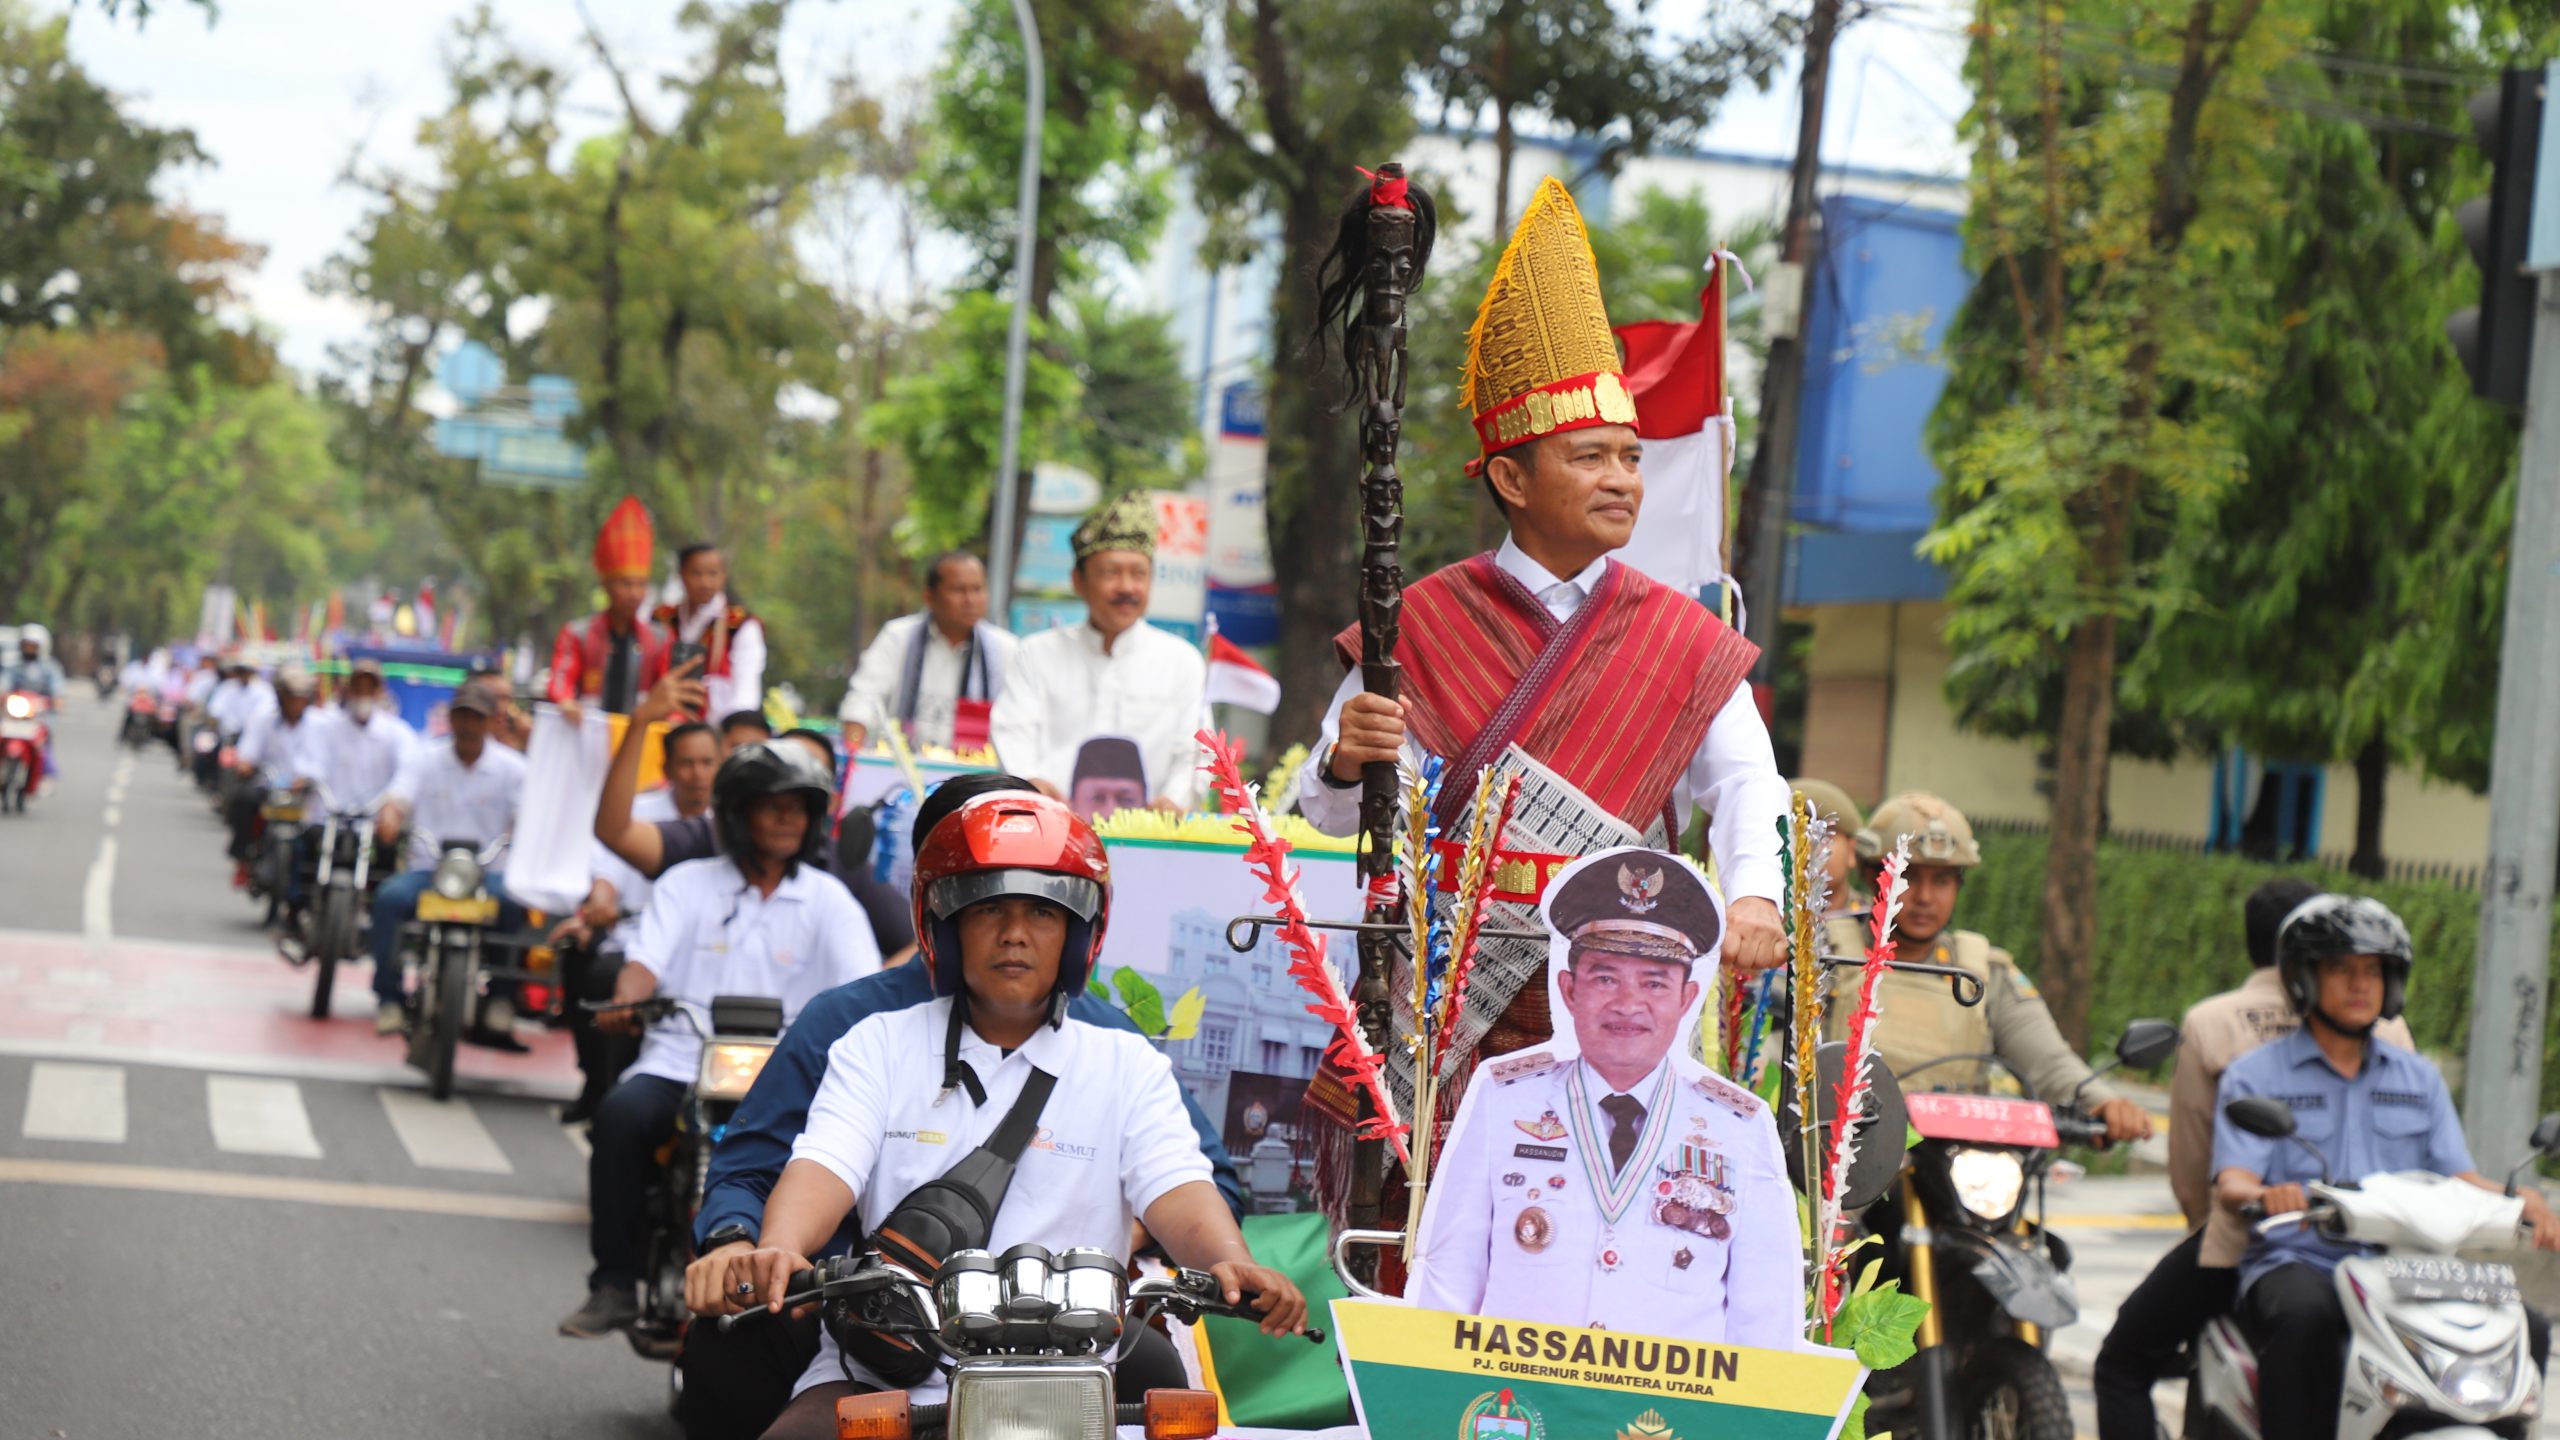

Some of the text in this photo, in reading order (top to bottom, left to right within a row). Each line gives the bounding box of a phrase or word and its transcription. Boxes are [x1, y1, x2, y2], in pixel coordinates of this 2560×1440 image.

[1454, 1319, 1738, 1382] HASSANUDIN
[1473, 1358, 1713, 1396] PJ. GUBERNUR SUMATERA UTARA
